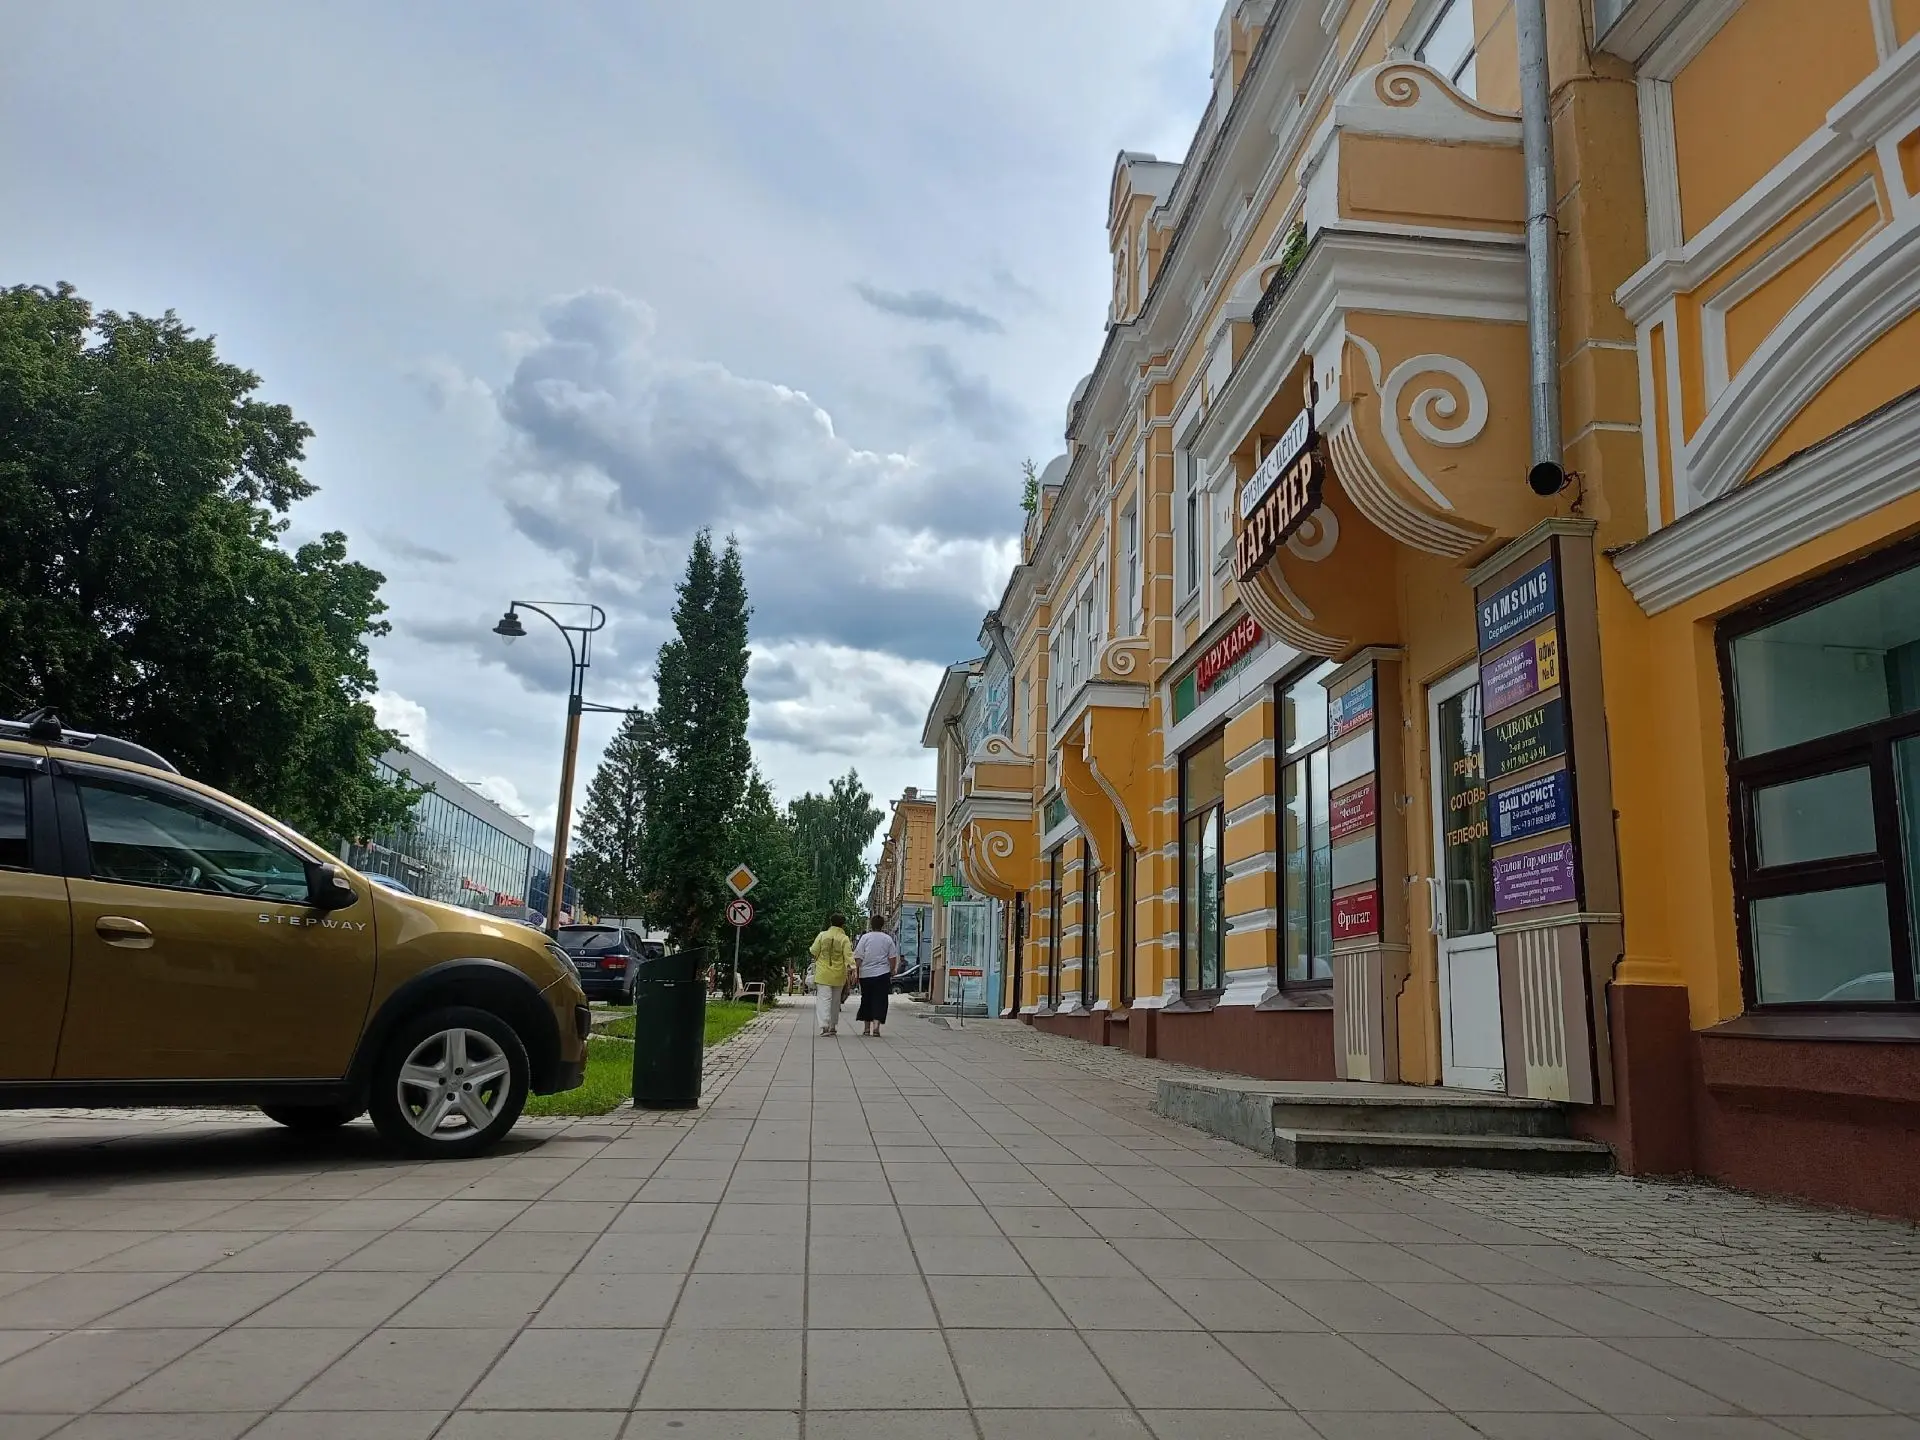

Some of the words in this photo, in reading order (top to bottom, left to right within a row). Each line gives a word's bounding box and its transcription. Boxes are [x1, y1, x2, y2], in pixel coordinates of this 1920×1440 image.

[1236, 451, 1312, 581] ПАРТНЕР
[1484, 571, 1547, 627] SAMSUNG
[1488, 612, 1523, 640] Сервисный
[1523, 602, 1545, 621] Центр
[1197, 615, 1255, 688] ДАРУХАНӘ
[1499, 708, 1545, 742] АДВОКАТ
[1453, 751, 1485, 777] РЕМО
[1499, 795, 1520, 814] ВАШ
[1521, 783, 1555, 806] ЮРИСТ
[1500, 860, 1522, 874] салон
[1523, 850, 1563, 870] Гармония
[258, 914, 367, 931] STEPWAY
[1337, 910, 1371, 931] Фригат
